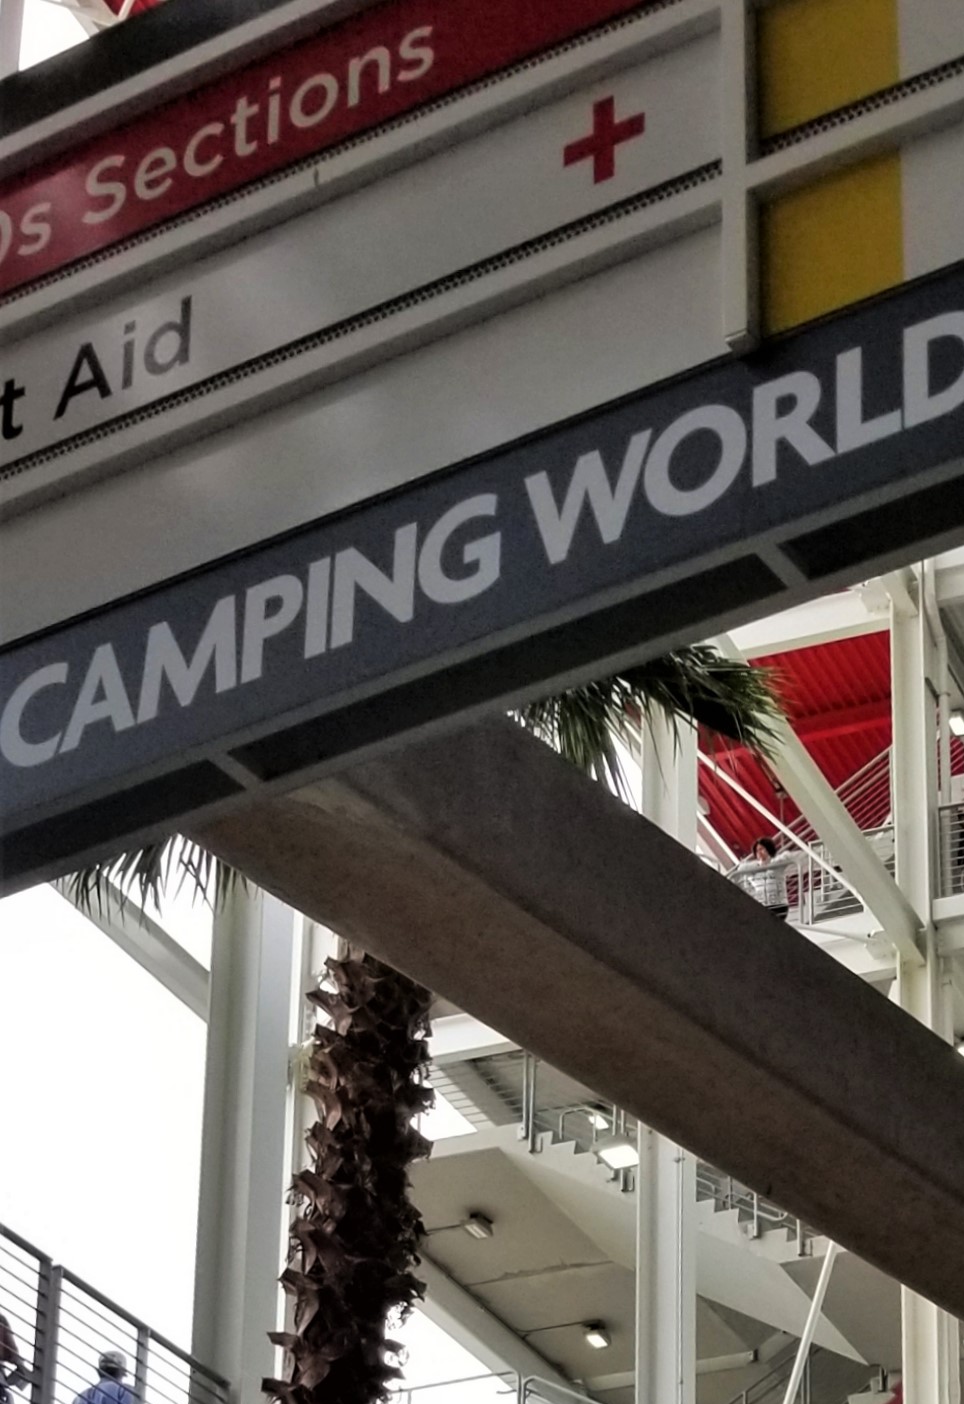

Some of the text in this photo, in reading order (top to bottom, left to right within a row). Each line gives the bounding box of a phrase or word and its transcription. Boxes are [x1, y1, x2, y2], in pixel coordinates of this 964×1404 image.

[82, 24, 435, 225] Sections
[53, 295, 192, 420] Aid
[0, 492, 501, 768] CAMPING
